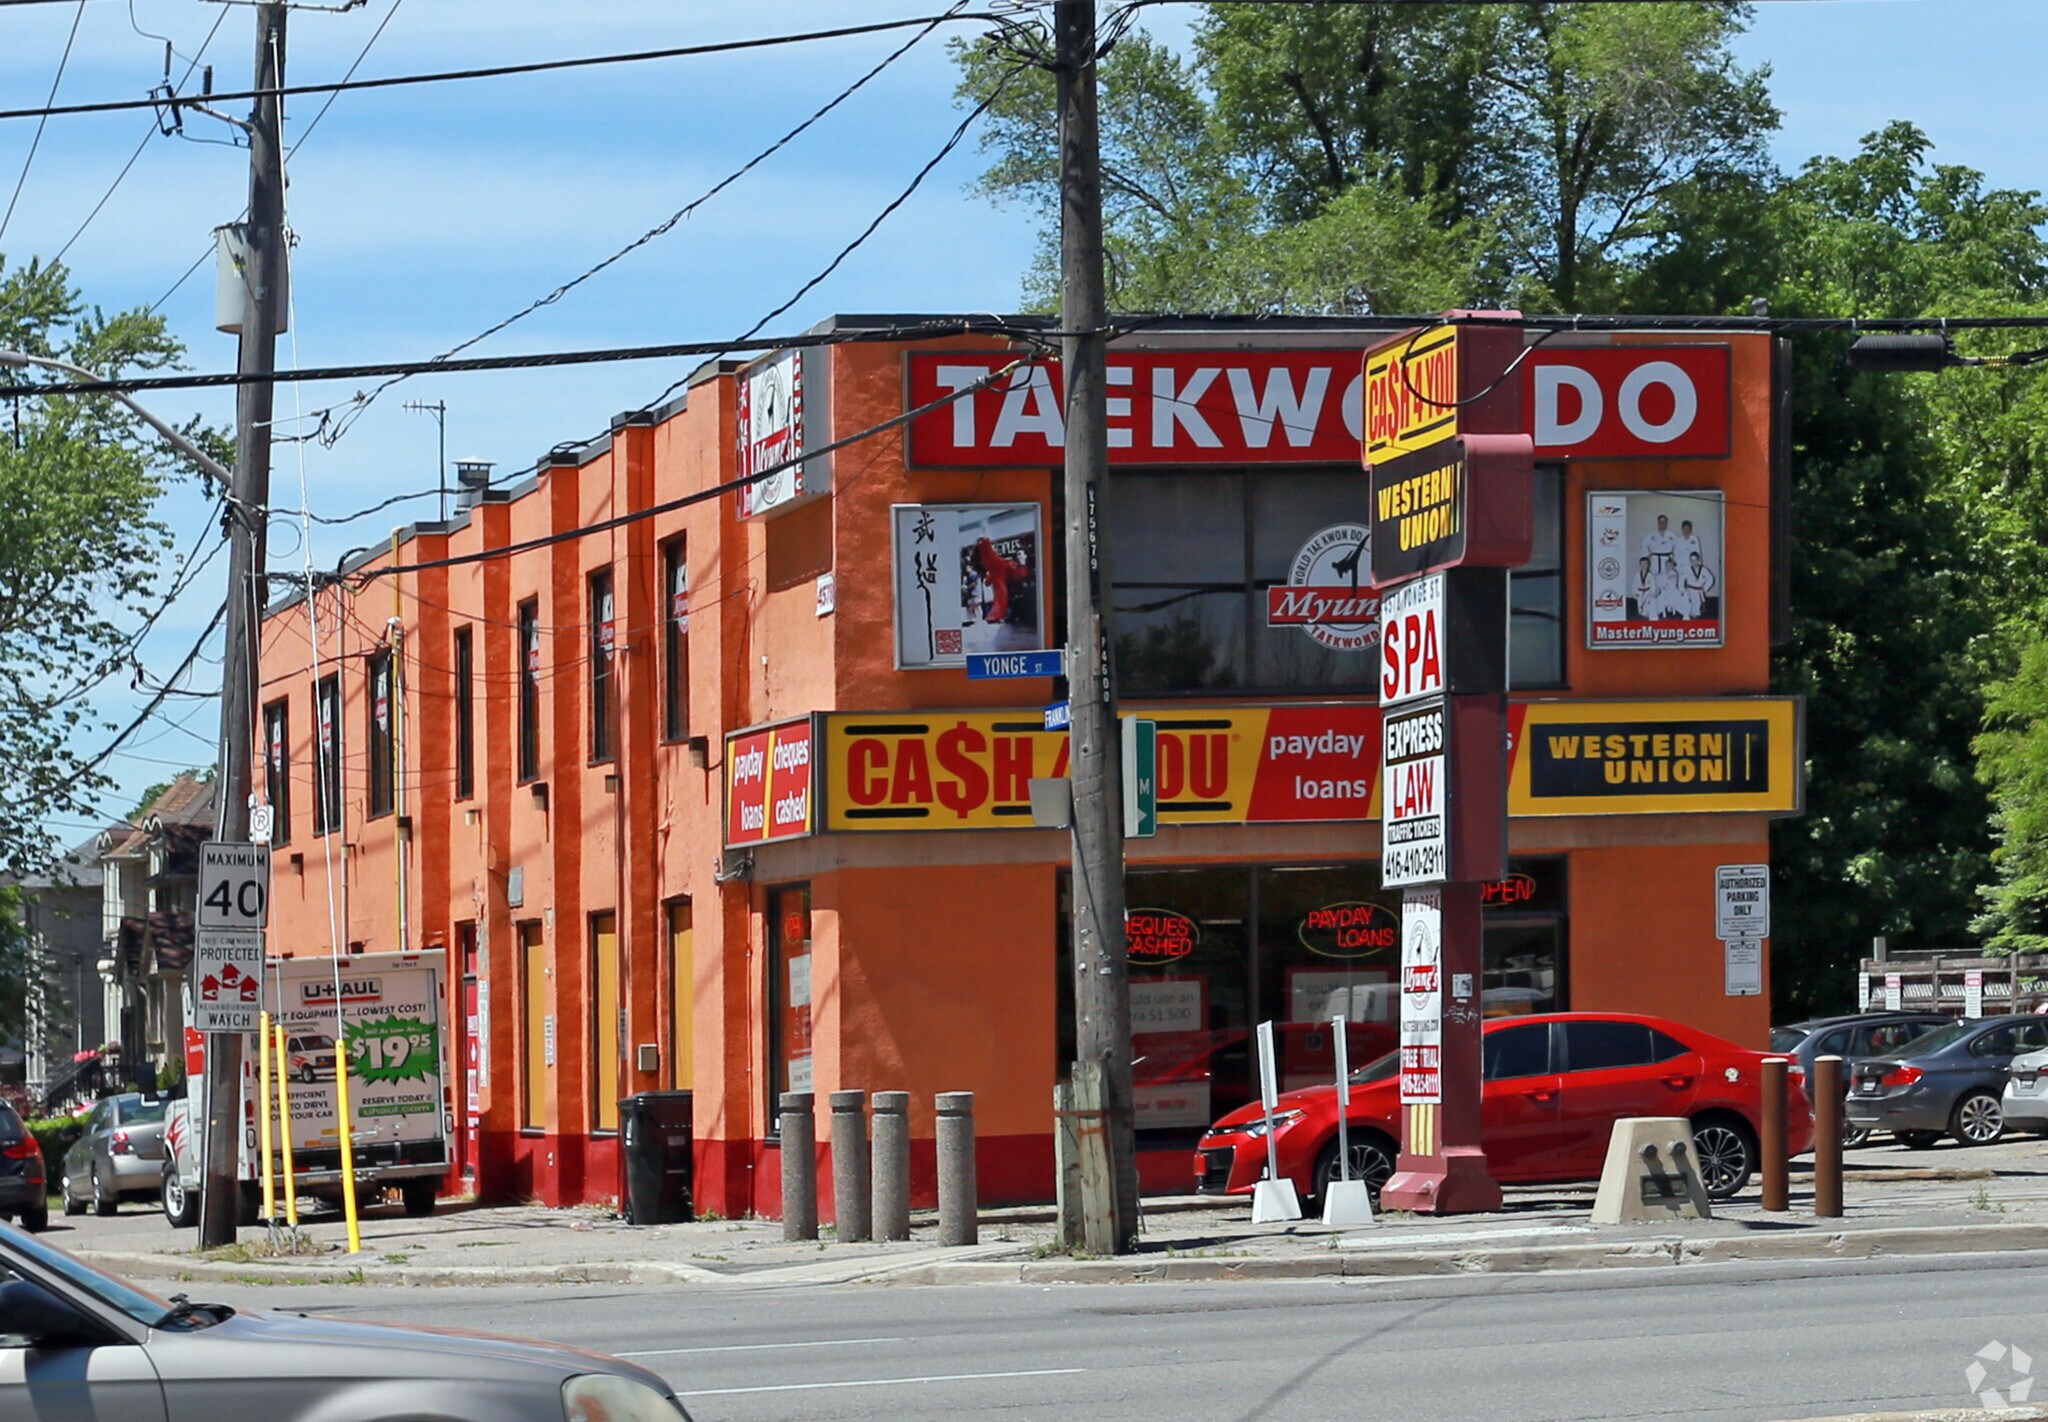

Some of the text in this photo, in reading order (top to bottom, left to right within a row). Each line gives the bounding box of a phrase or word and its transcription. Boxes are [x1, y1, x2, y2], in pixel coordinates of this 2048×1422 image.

[1413, 361, 1423, 423] 4
[1425, 347, 1455, 419] YOU
[936, 360, 1698, 448] TAEKWDO
[1378, 463, 1451, 522] WESTERN
[1400, 503, 1451, 552] UNION
[1294, 552, 1311, 585] WORLD
[1307, 540, 1323, 557] TAE
[1322, 529, 1348, 546] KWON
[1272, 591, 1380, 624] Myun
[1311, 625, 1380, 648] TAEKWOND
[1597, 625, 1716, 643] MasterMyung.com
[984, 657, 1043, 675] YONGE ST
[1383, 608, 1441, 700] SPA
[1270, 729, 1365, 760] payday
[1387, 712, 1443, 761] EXPRESS
[1548, 733, 1723, 759] WESTERN
[734, 745, 763, 787] payday
[773, 738, 809, 774] cheques
[1156, 733, 1229, 799] OU
[847, 721, 1033, 819] CA$H
[1604, 758, 1723, 784] UNION
[1295, 775, 1367, 800] loans
[1394, 759, 1434, 819] LAW
[741, 800, 763, 831] loans
[775, 787, 806, 825] cashed
[206, 852, 265, 867] MAXIMUM
[1386, 844, 1444, 881] 416-410-2911
[1481, 880, 1530, 902] PEN
[1720, 878, 1765, 890] AUTHORIZED
[1727, 891, 1759, 902] PARKING
[204, 879, 264, 918] 40
[1733, 905, 1752, 916] ONLY
[1125, 916, 1190, 937] EQUES
[1309, 906, 1374, 929] PAYDAY
[1337, 928, 1394, 947] LOANS
[209, 1013, 250, 1026] WATCH
[398, 1004, 426, 1013] COST!
[303, 1100, 328, 1109] DRIVE
[362, 1097, 395, 1105] RESERVE
[398, 1094, 424, 1103] TODAY
[290, 1110, 333, 1120] YOUR CAR
